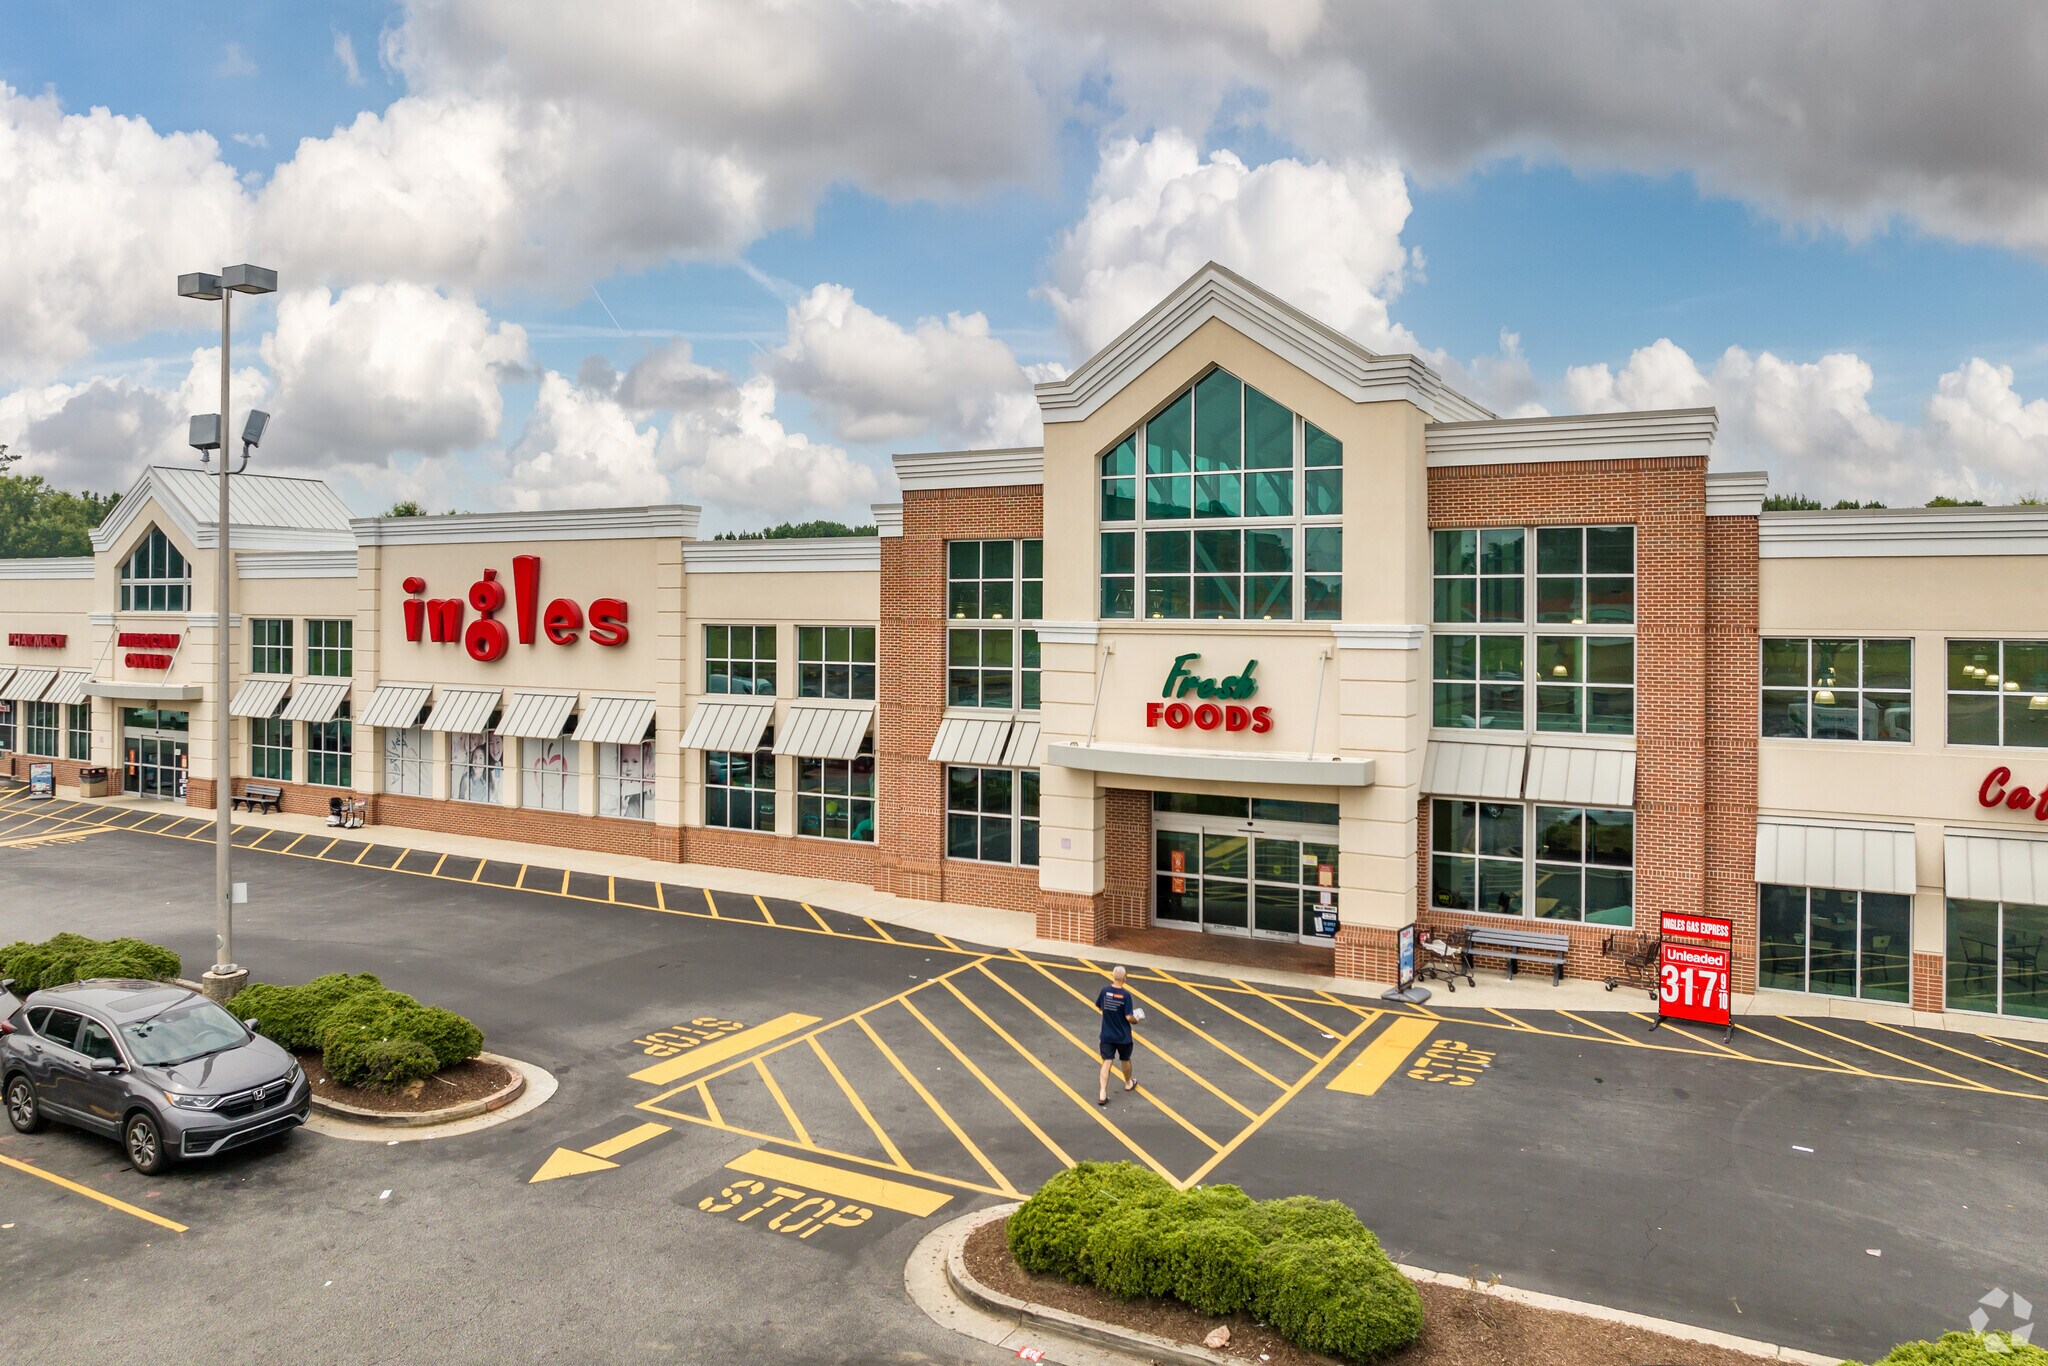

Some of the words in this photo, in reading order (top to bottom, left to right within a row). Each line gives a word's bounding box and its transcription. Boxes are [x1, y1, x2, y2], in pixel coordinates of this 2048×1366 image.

[402, 554, 630, 662] ingles
[9, 633, 68, 648] PHARMACY
[1162, 652, 1259, 700] Fresh
[1146, 702, 1273, 734] FOODS
[1663, 917, 1686, 932] INGLES
[1686, 920, 1700, 934] GAS
[1700, 922, 1729, 938] EXPRESS
[1667, 948, 1723, 967] Unleaded
[1661, 964, 1718, 1008] 317
[633, 1017, 744, 1057] STOP
[1406, 1039, 1497, 1087] STOP
[698, 1179, 873, 1239] STOP
